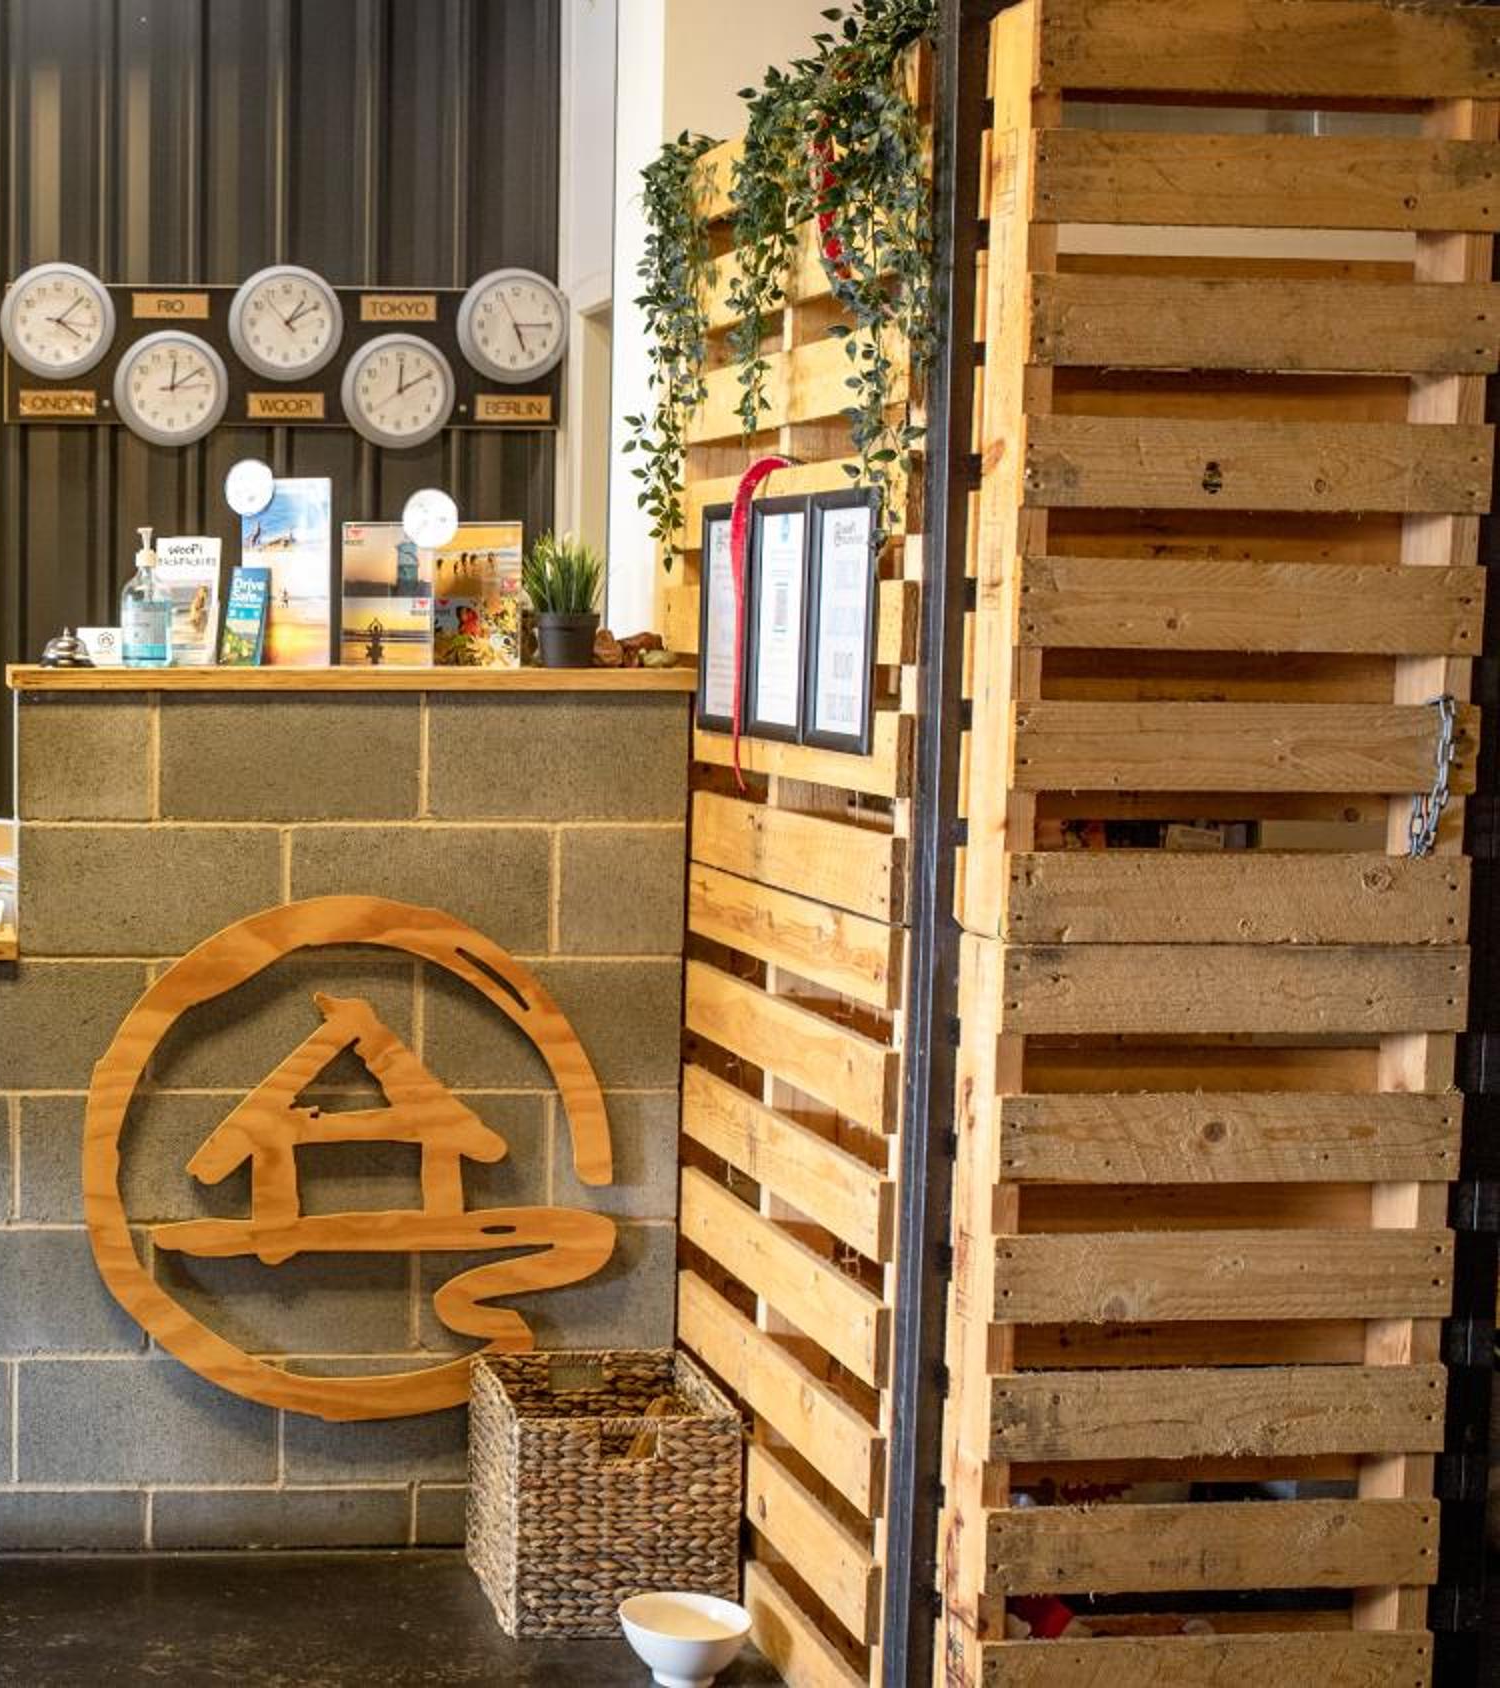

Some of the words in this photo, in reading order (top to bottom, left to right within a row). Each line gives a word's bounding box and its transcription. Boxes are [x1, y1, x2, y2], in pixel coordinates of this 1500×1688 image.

[156, 298, 186, 313] RIO
[370, 300, 429, 316] TOKYO
[259, 398, 313, 414] WOOPI
[484, 400, 543, 416] BERLIN
[232, 577, 265, 591] Drive
